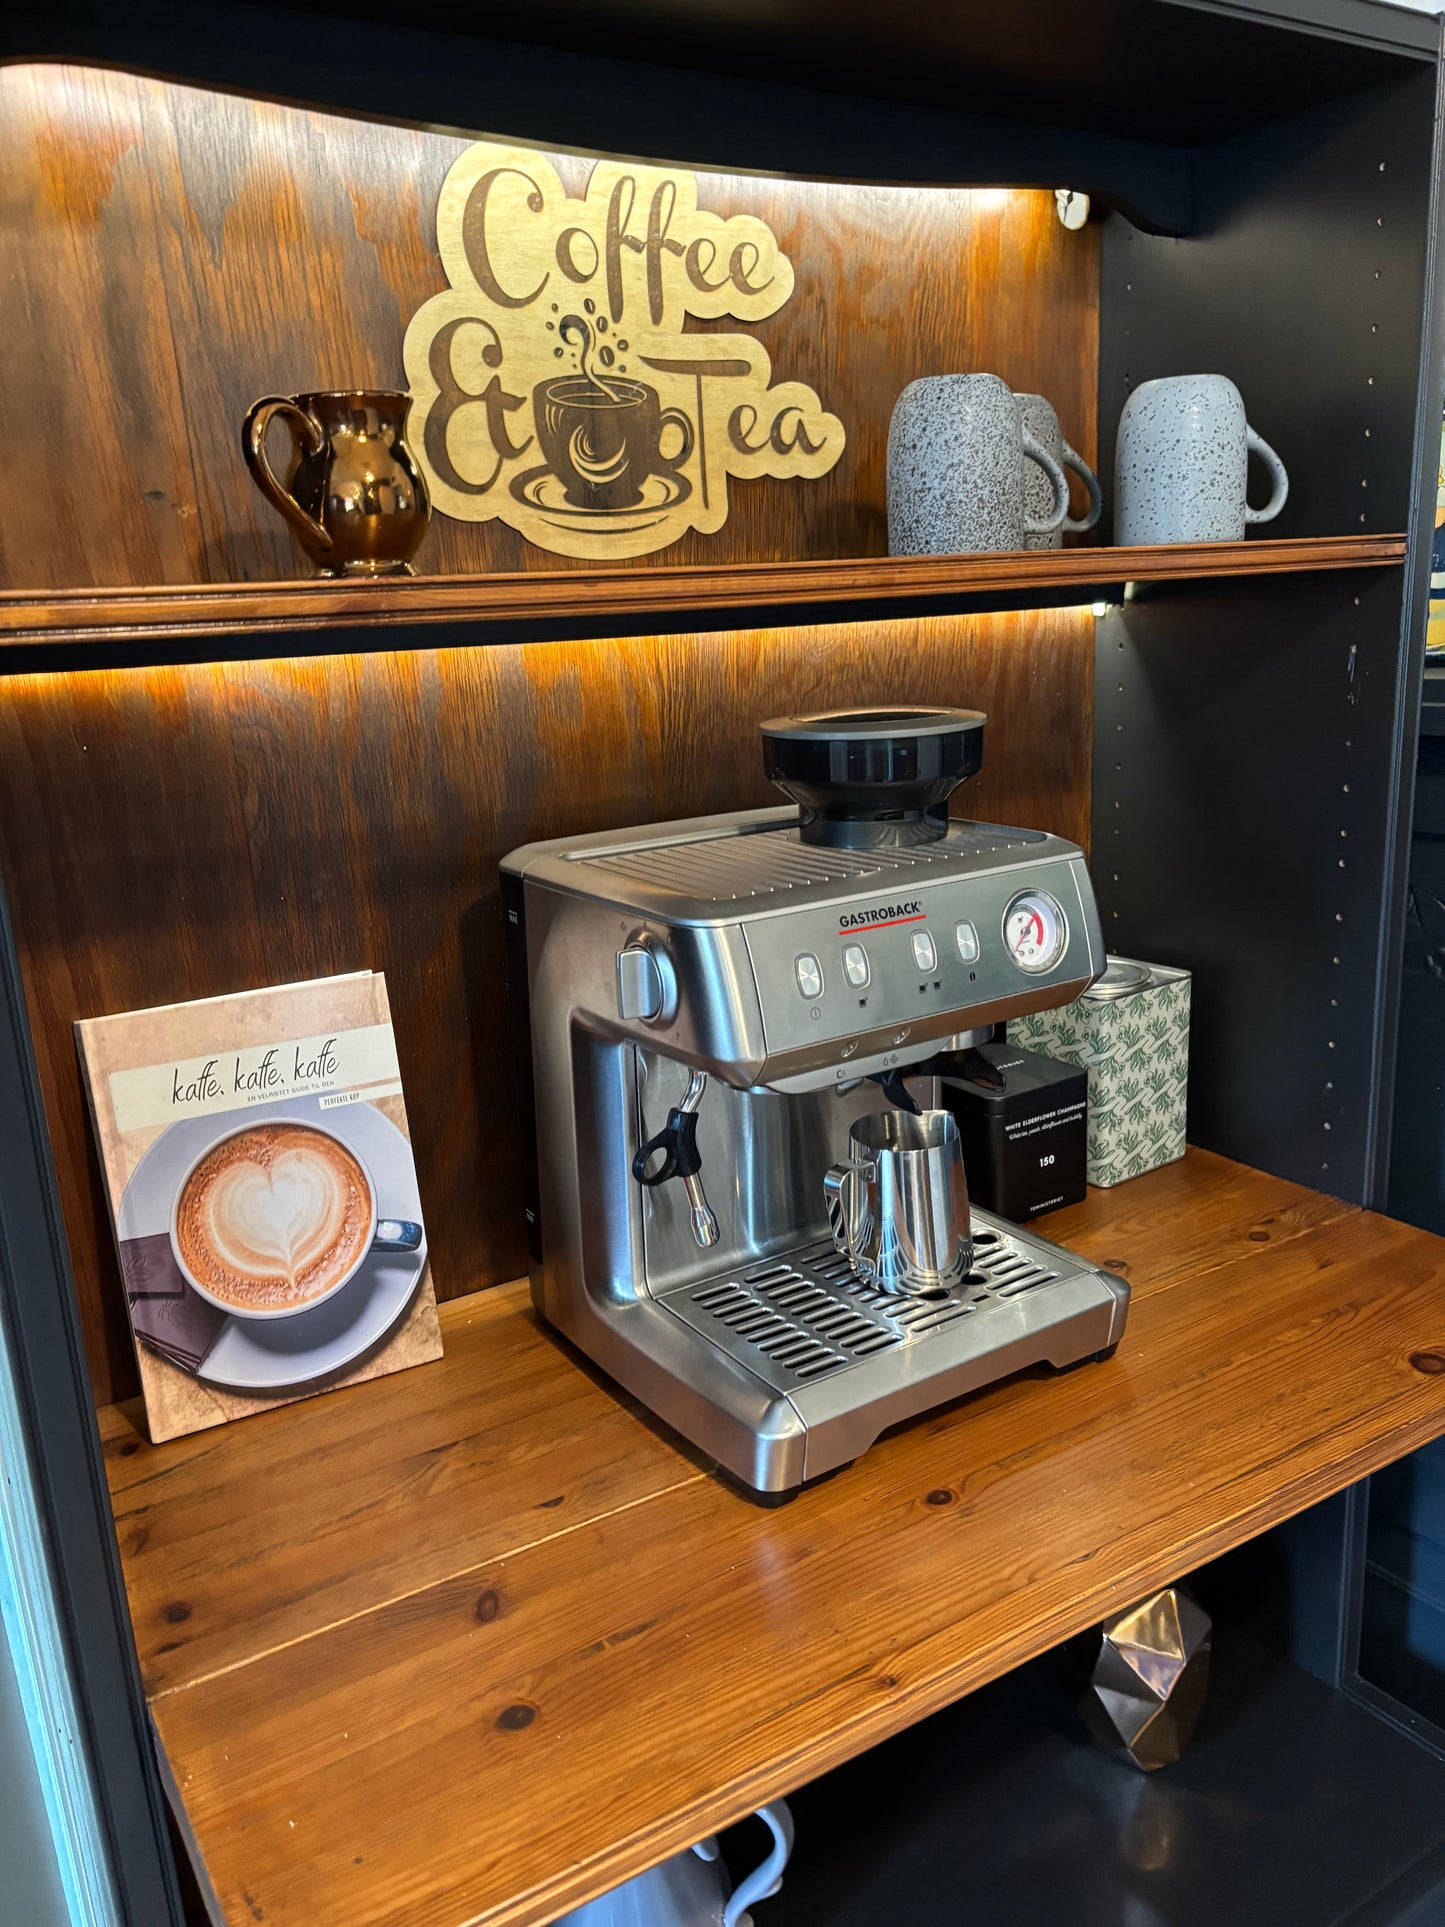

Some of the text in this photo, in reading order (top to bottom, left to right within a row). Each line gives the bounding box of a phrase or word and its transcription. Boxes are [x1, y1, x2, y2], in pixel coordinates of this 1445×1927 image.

[462, 167, 776, 326] Coffee
[423, 316, 828, 511] & Tea
[293, 1038, 341, 1081] kaffe
[291, 1084, 310, 1093] GUIDE
[321, 1080, 335, 1088] DEN
[1005, 1101, 1087, 1132] WHITE ELDERFLOWER CHAMPAGNE
[1039, 1154, 1055, 1168] 150
